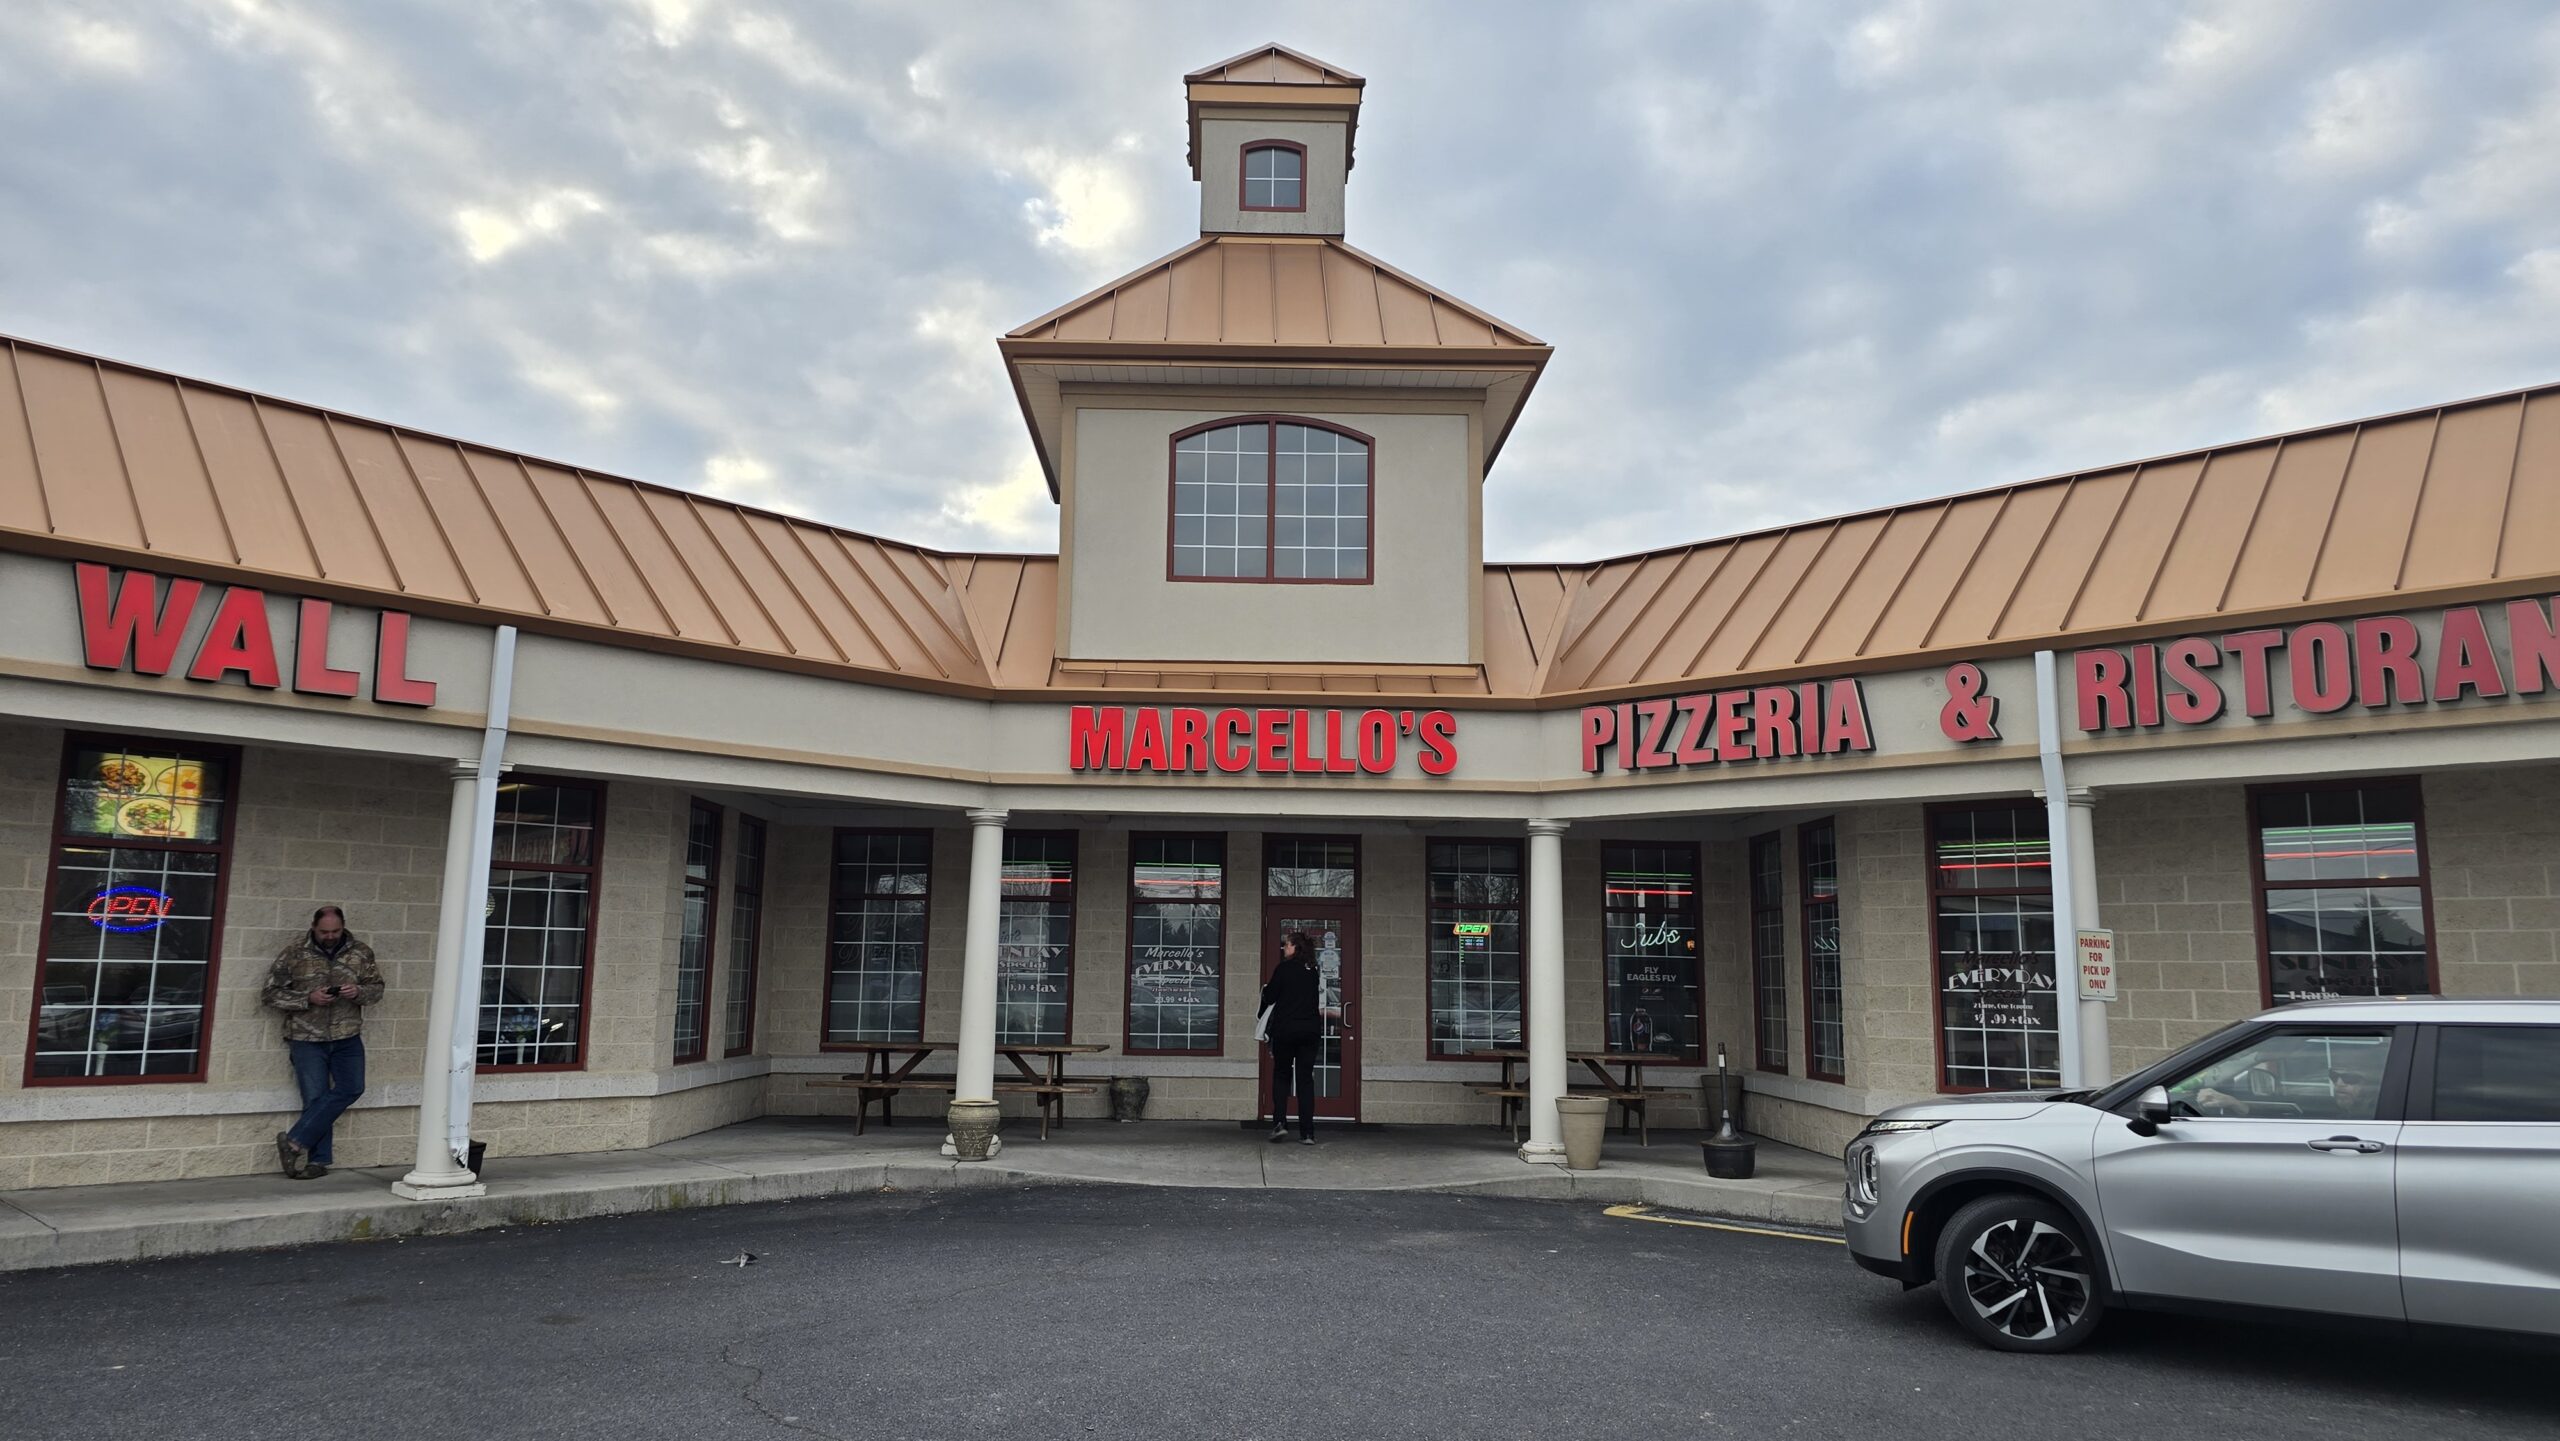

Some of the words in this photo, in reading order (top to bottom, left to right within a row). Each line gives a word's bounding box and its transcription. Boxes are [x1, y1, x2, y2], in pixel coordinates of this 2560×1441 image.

[74, 561, 437, 707] WALL
[1070, 705, 1458, 775] MARCELLO'S
[1580, 678, 1875, 773] PIZZERIA
[1940, 662, 2001, 742] &
[87, 896, 174, 921] OPEN
[1455, 924, 1489, 933] OPEN
[1620, 920, 1681, 949] Subs
[2080, 938, 2111, 949] PARKING
[1144, 947, 1205, 958] Marcello's
[1961, 951, 2040, 965] Marcello's
[2089, 952, 2103, 962] FOR
[1135, 959, 1215, 978] EVERYDAY
[1644, 966, 1660, 975] FLY
[2083, 965, 2099, 976] PICK
[2101, 966, 2111, 976] UP
[1626, 974, 1661, 982] EAGLES
[1662, 974, 1677, 983] FLY
[1948, 967, 2056, 991] EVERYDAY
[2089, 979, 2106, 989] ONLY
